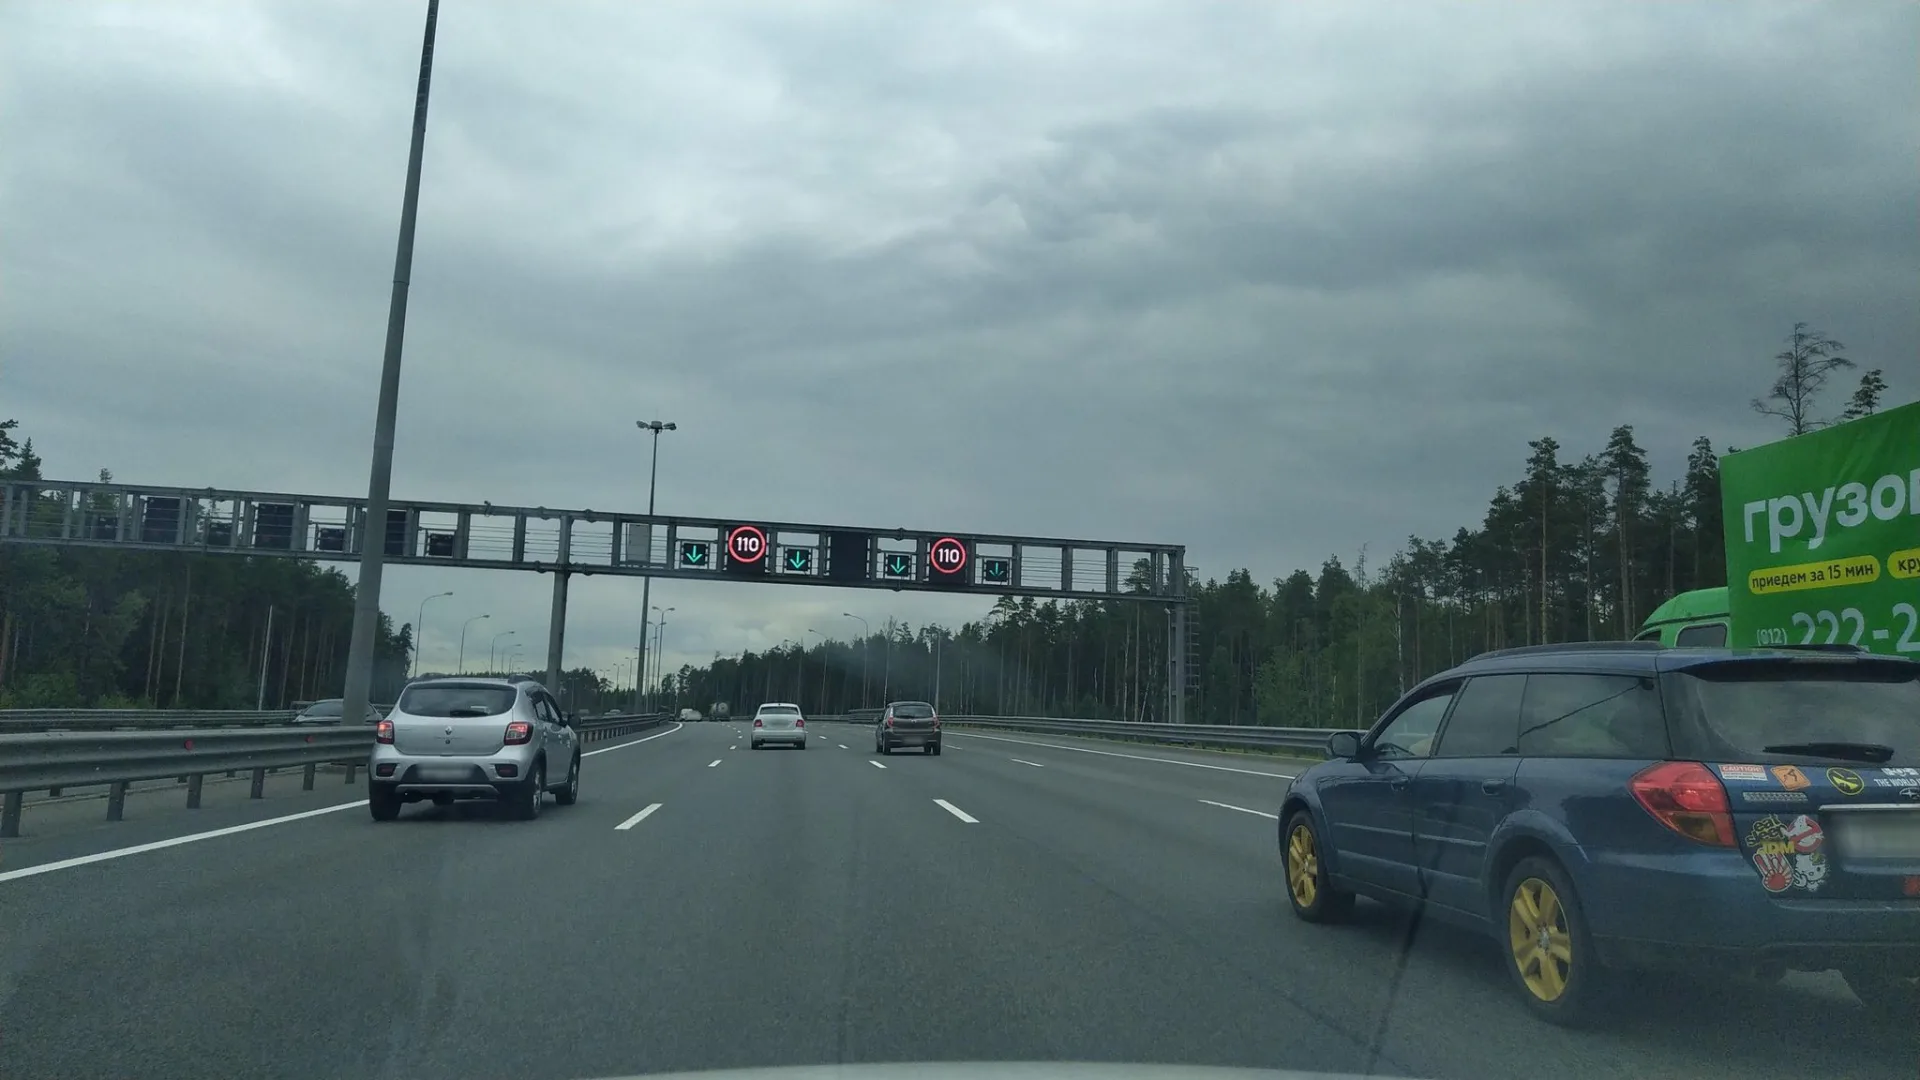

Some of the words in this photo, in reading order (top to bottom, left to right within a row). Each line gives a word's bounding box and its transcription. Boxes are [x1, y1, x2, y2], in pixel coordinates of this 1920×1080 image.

[736, 537, 759, 552] 110
[938, 548, 960, 563] 110
[1752, 571, 1806, 589] приедем
[1810, 570, 1825, 582] за
[1828, 565, 1840, 580] 15
[1845, 564, 1874, 577] мин
[1873, 778, 1892, 787] THE
[1889, 778, 1918, 787] WORLD
[1754, 814, 1779, 830] eat
[1757, 841, 1795, 854] JDM
